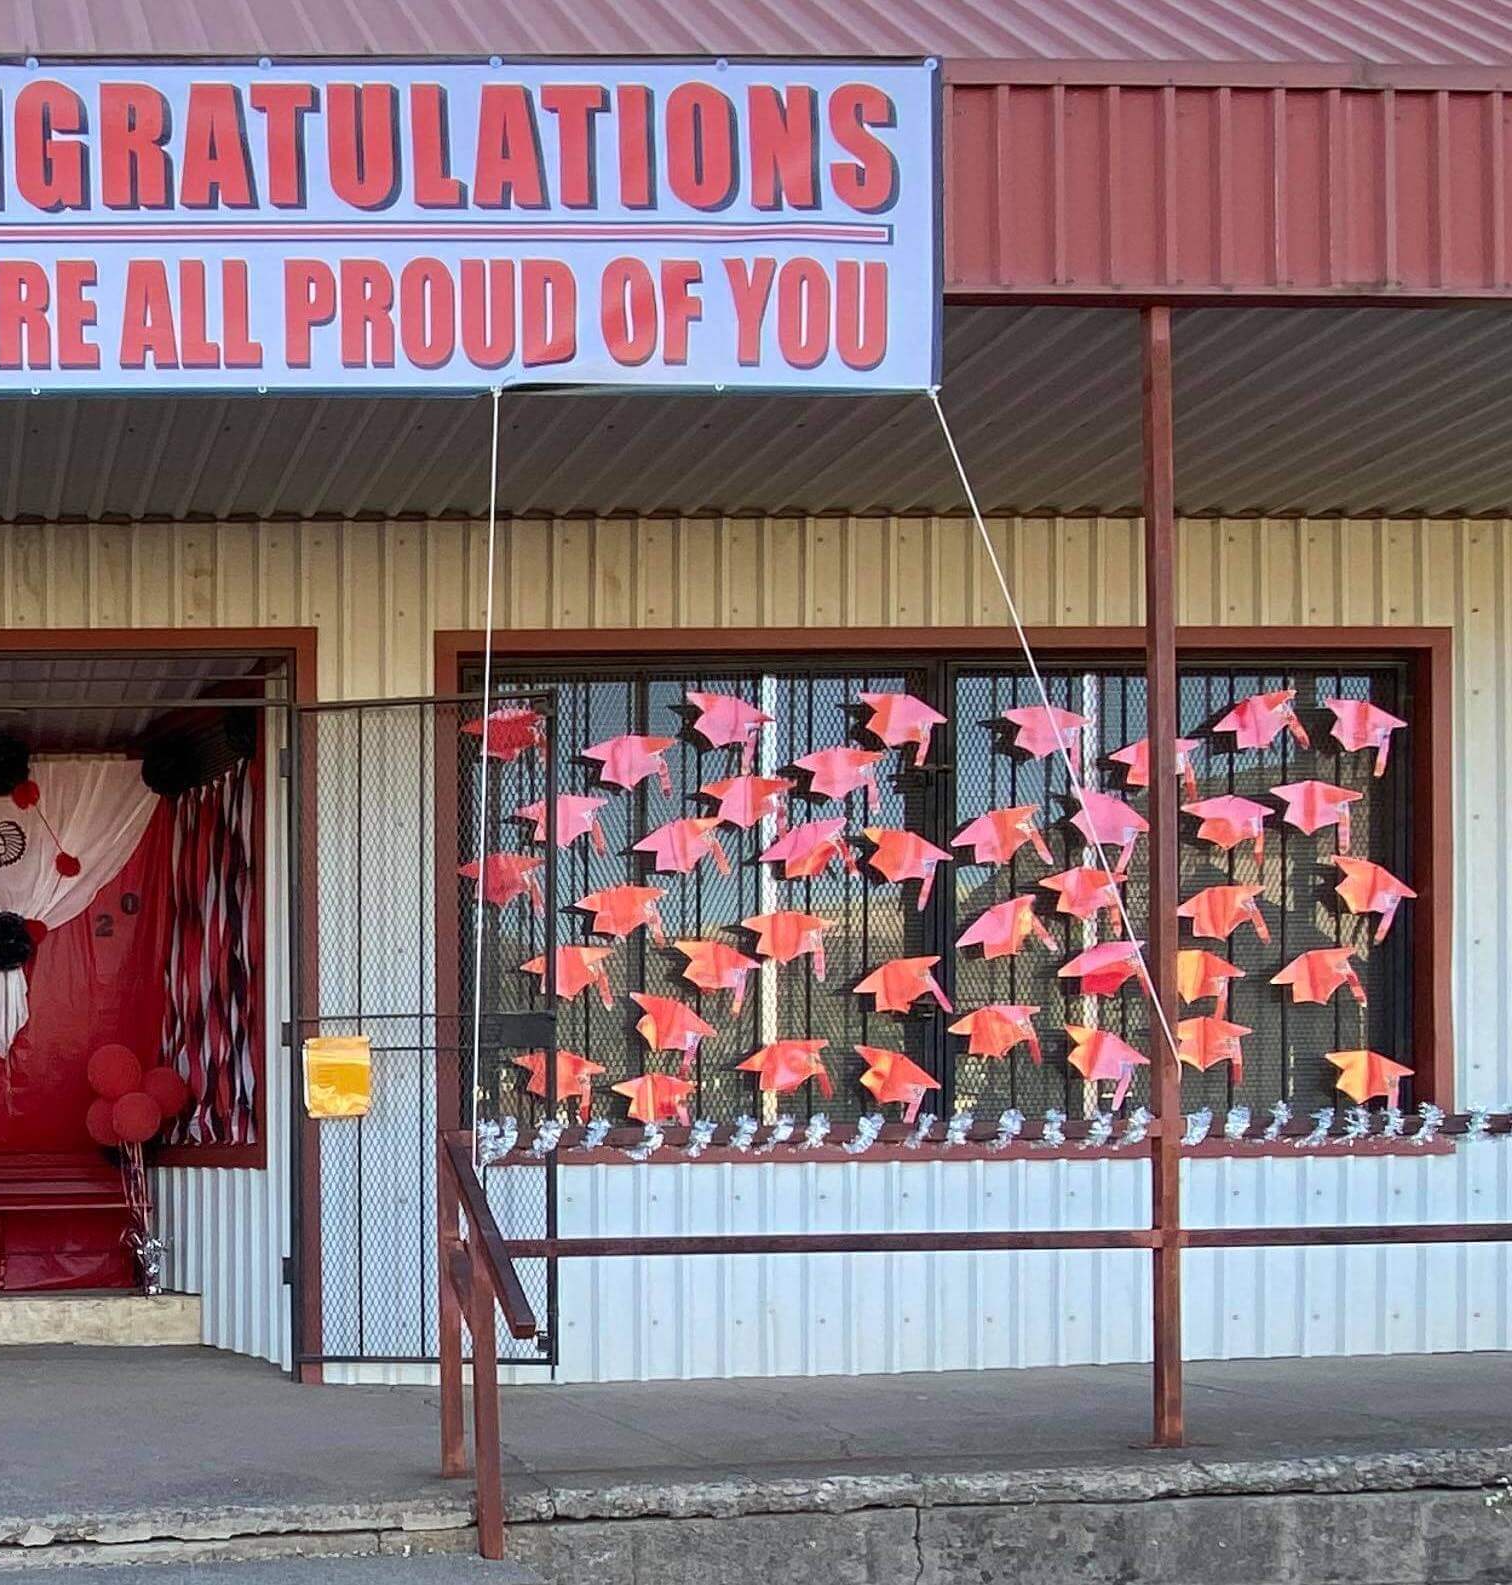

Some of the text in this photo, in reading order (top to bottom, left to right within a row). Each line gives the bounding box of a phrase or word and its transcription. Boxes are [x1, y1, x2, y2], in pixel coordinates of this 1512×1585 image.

[120, 258, 263, 370] ALL
[284, 257, 578, 369] PROUD
[600, 256, 703, 368] OF
[722, 256, 889, 370] YOU
